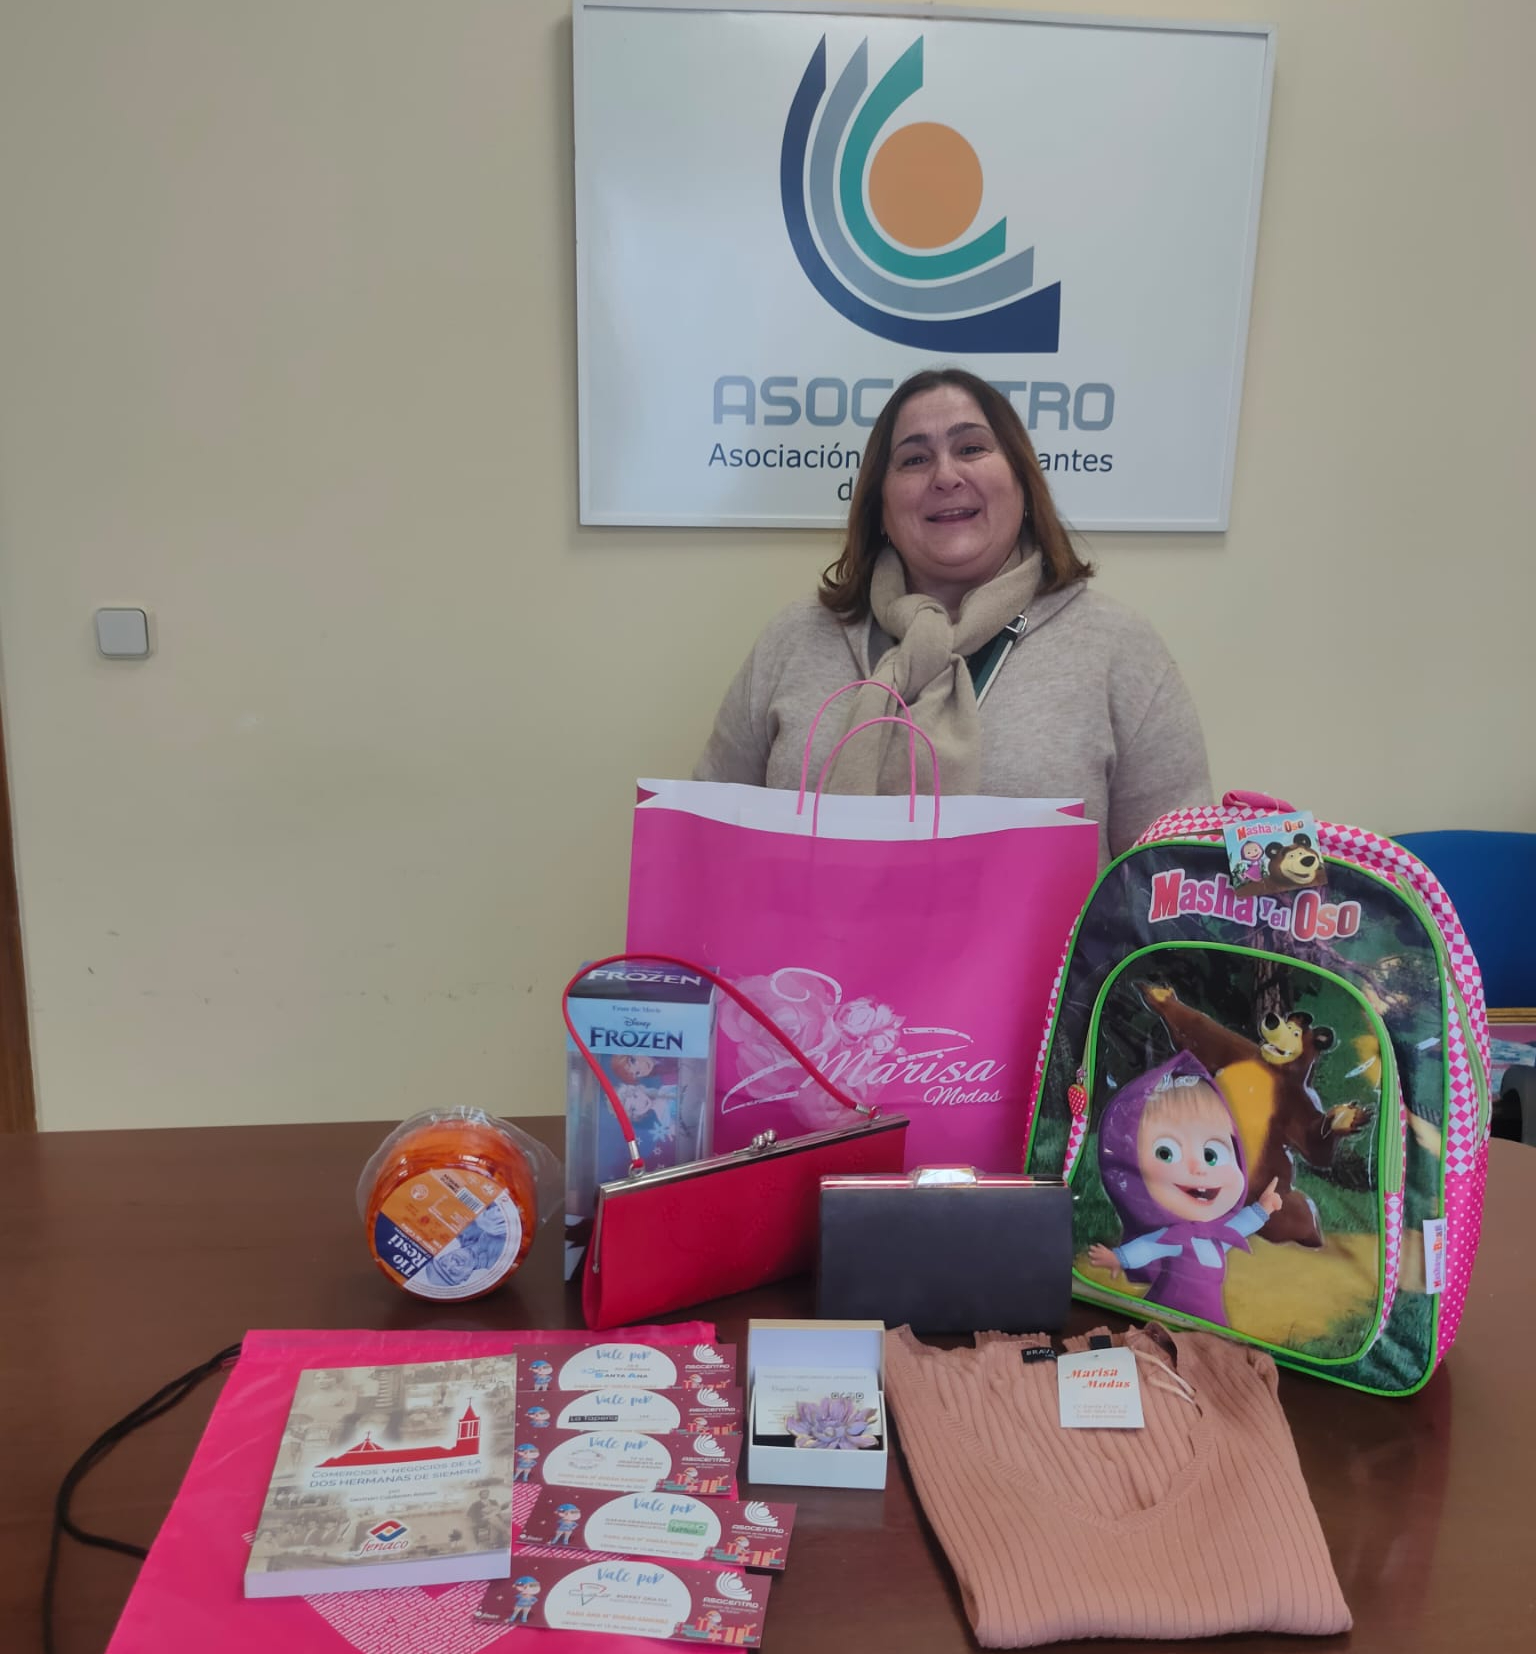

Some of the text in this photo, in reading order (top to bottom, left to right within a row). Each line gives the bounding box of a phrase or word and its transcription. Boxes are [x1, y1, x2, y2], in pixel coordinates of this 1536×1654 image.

[713, 375, 1115, 431] ASOCTRO
[708, 442, 860, 469] Asociación
[1237, 823, 1272, 841] Masha
[1284, 820, 1304, 833] Oso
[1150, 870, 1255, 926] Masha
[1270, 909, 1288, 928] el
[1294, 890, 1360, 940] Oso
[587, 969, 702, 986] FROZEN
[624, 1016, 651, 1029] Disney
[590, 1026, 683, 1050] FROZEN
[801, 1050, 1007, 1089] Marisa
[923, 1085, 1002, 1106] Modas
[387, 1234, 428, 1269] Resti
[1066, 1367, 1119, 1380] Marisa
[1082, 1379, 1131, 1389] Modas
[589, 1436, 619, 1449] Vale
[309, 1466, 481, 1488] DOS HERMANAS DE SIEMPRE
[382, 1467, 389, 1475] Y
[633, 1498, 664, 1513] Vale
[597, 1567, 630, 1582] Vale
